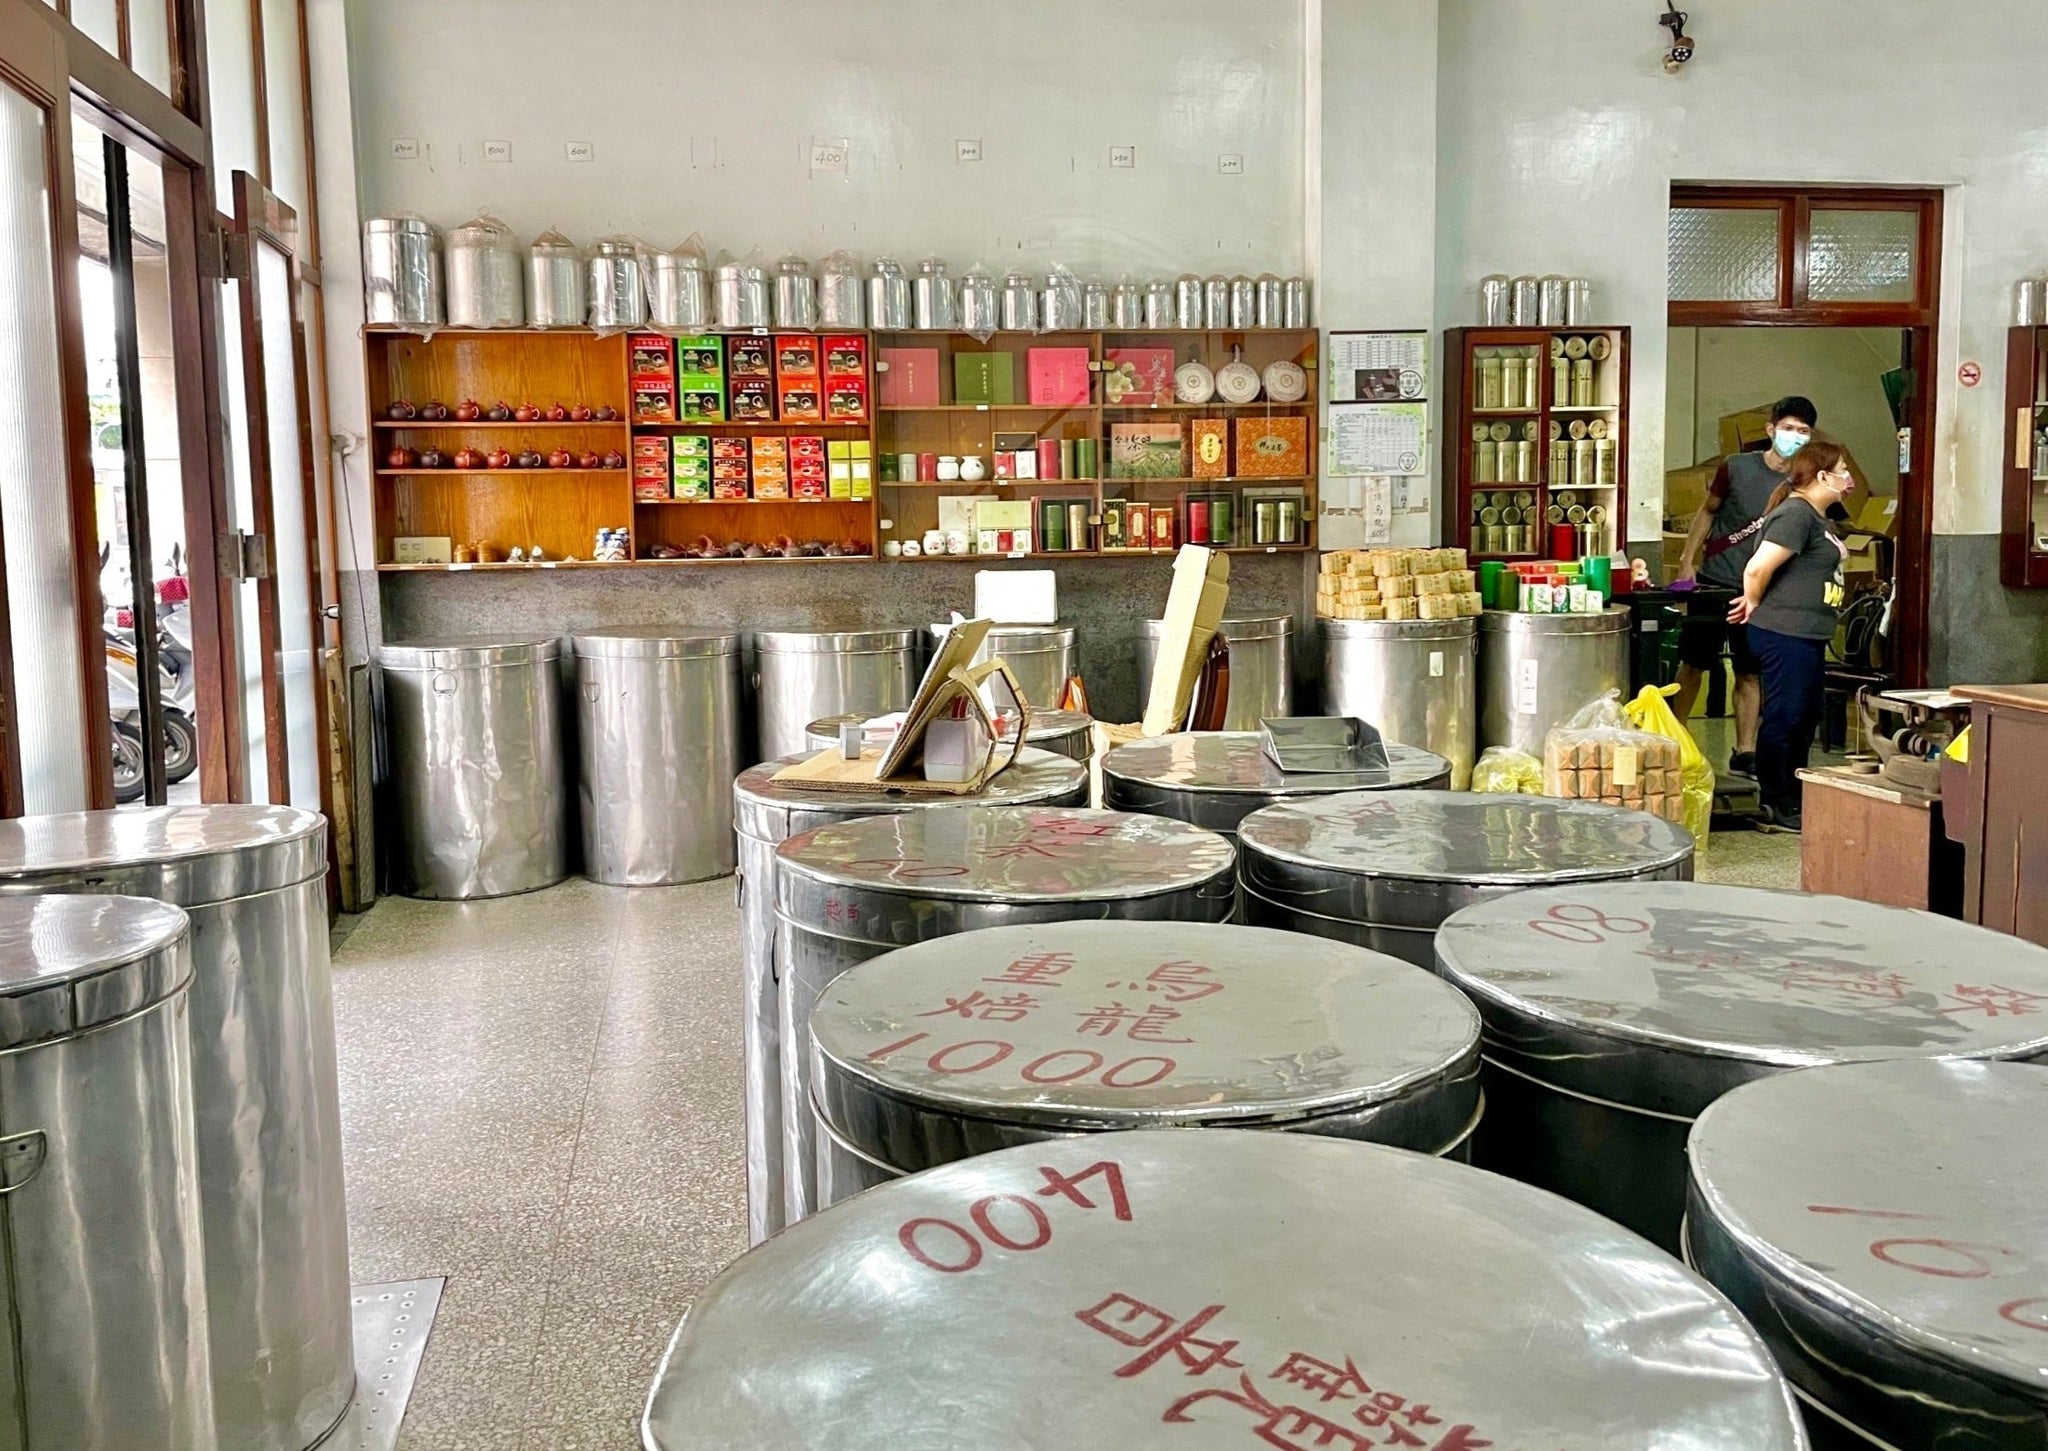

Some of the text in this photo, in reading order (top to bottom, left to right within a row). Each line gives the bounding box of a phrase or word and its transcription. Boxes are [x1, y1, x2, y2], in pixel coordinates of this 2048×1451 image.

[570, 147, 588, 156] 600
[814, 149, 842, 164] 400
[841, 858, 970, 878] 60
[916, 952, 1079, 1024] 重焙
[1074, 960, 1225, 1045] 烏龍
[868, 1030, 1177, 1089] 1000
[899, 1161, 1133, 1273] 400
